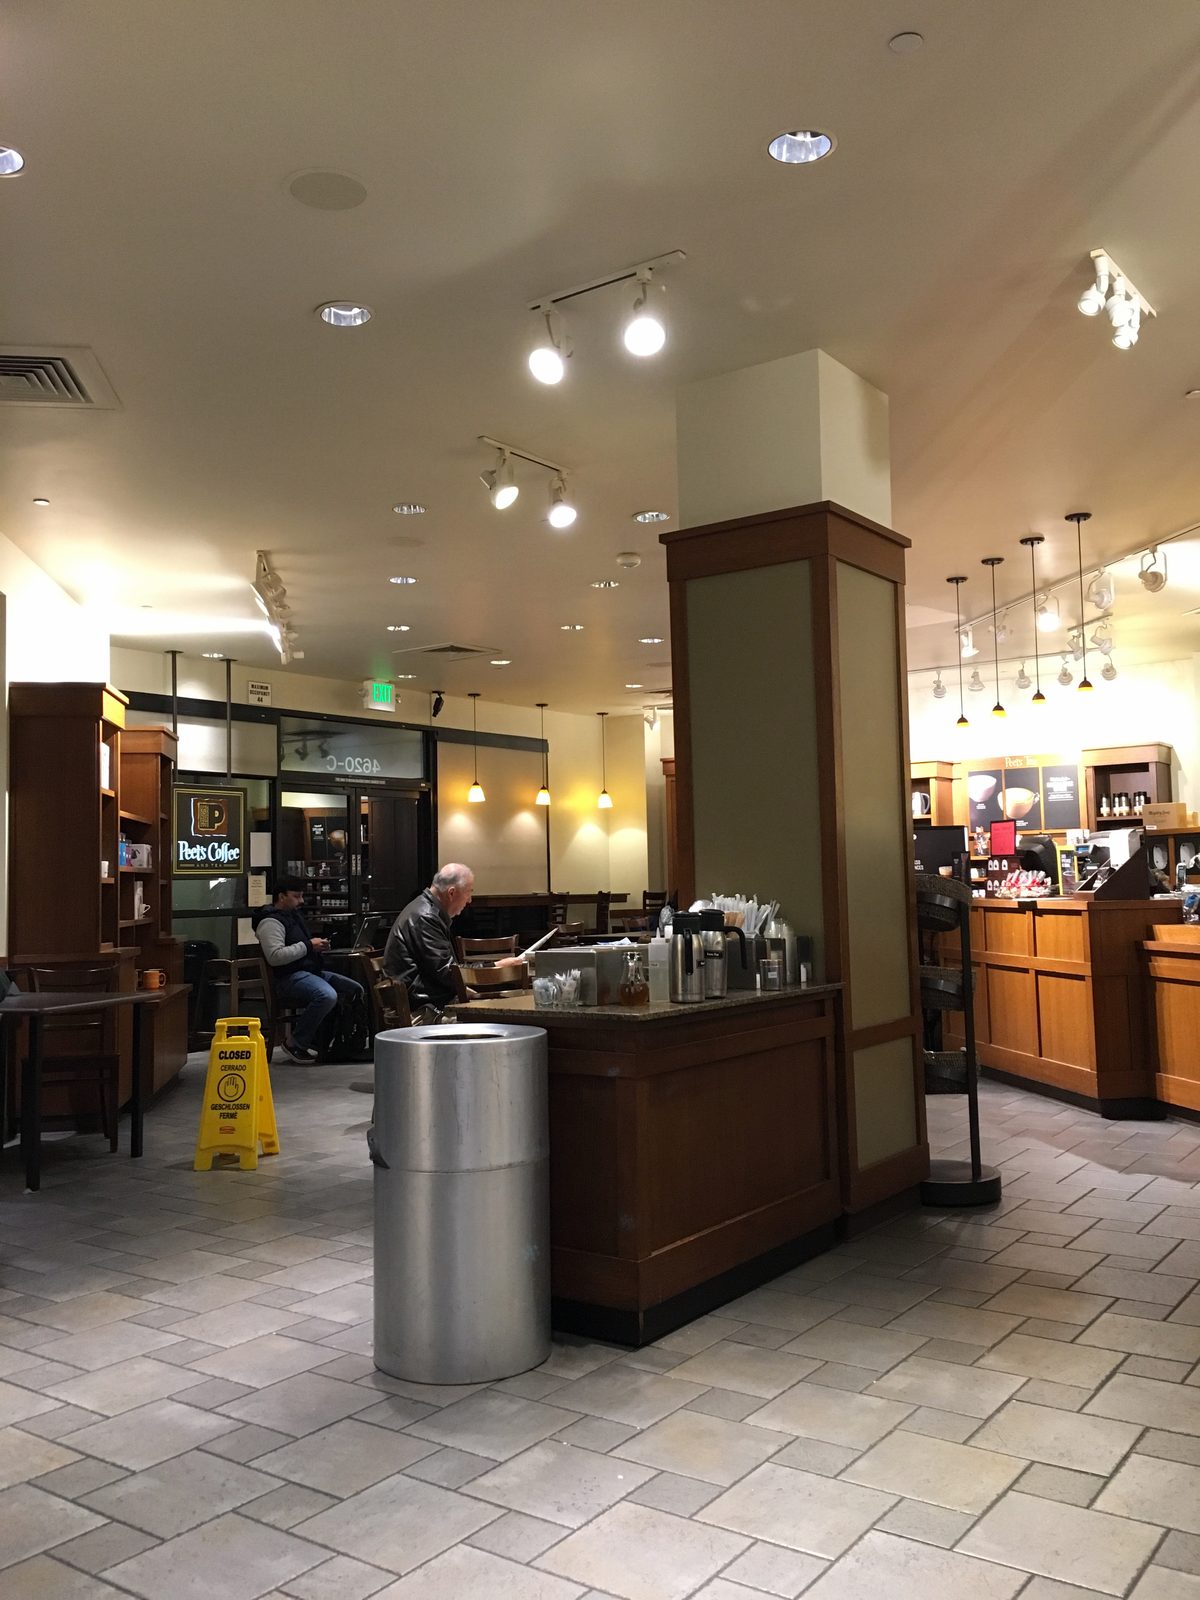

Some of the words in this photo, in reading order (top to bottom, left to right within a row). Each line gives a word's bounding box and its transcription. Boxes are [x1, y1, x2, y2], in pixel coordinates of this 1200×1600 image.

[373, 682, 392, 703] EXIT
[207, 841, 240, 863] Coffee
[219, 1050, 251, 1060] CLOSED
